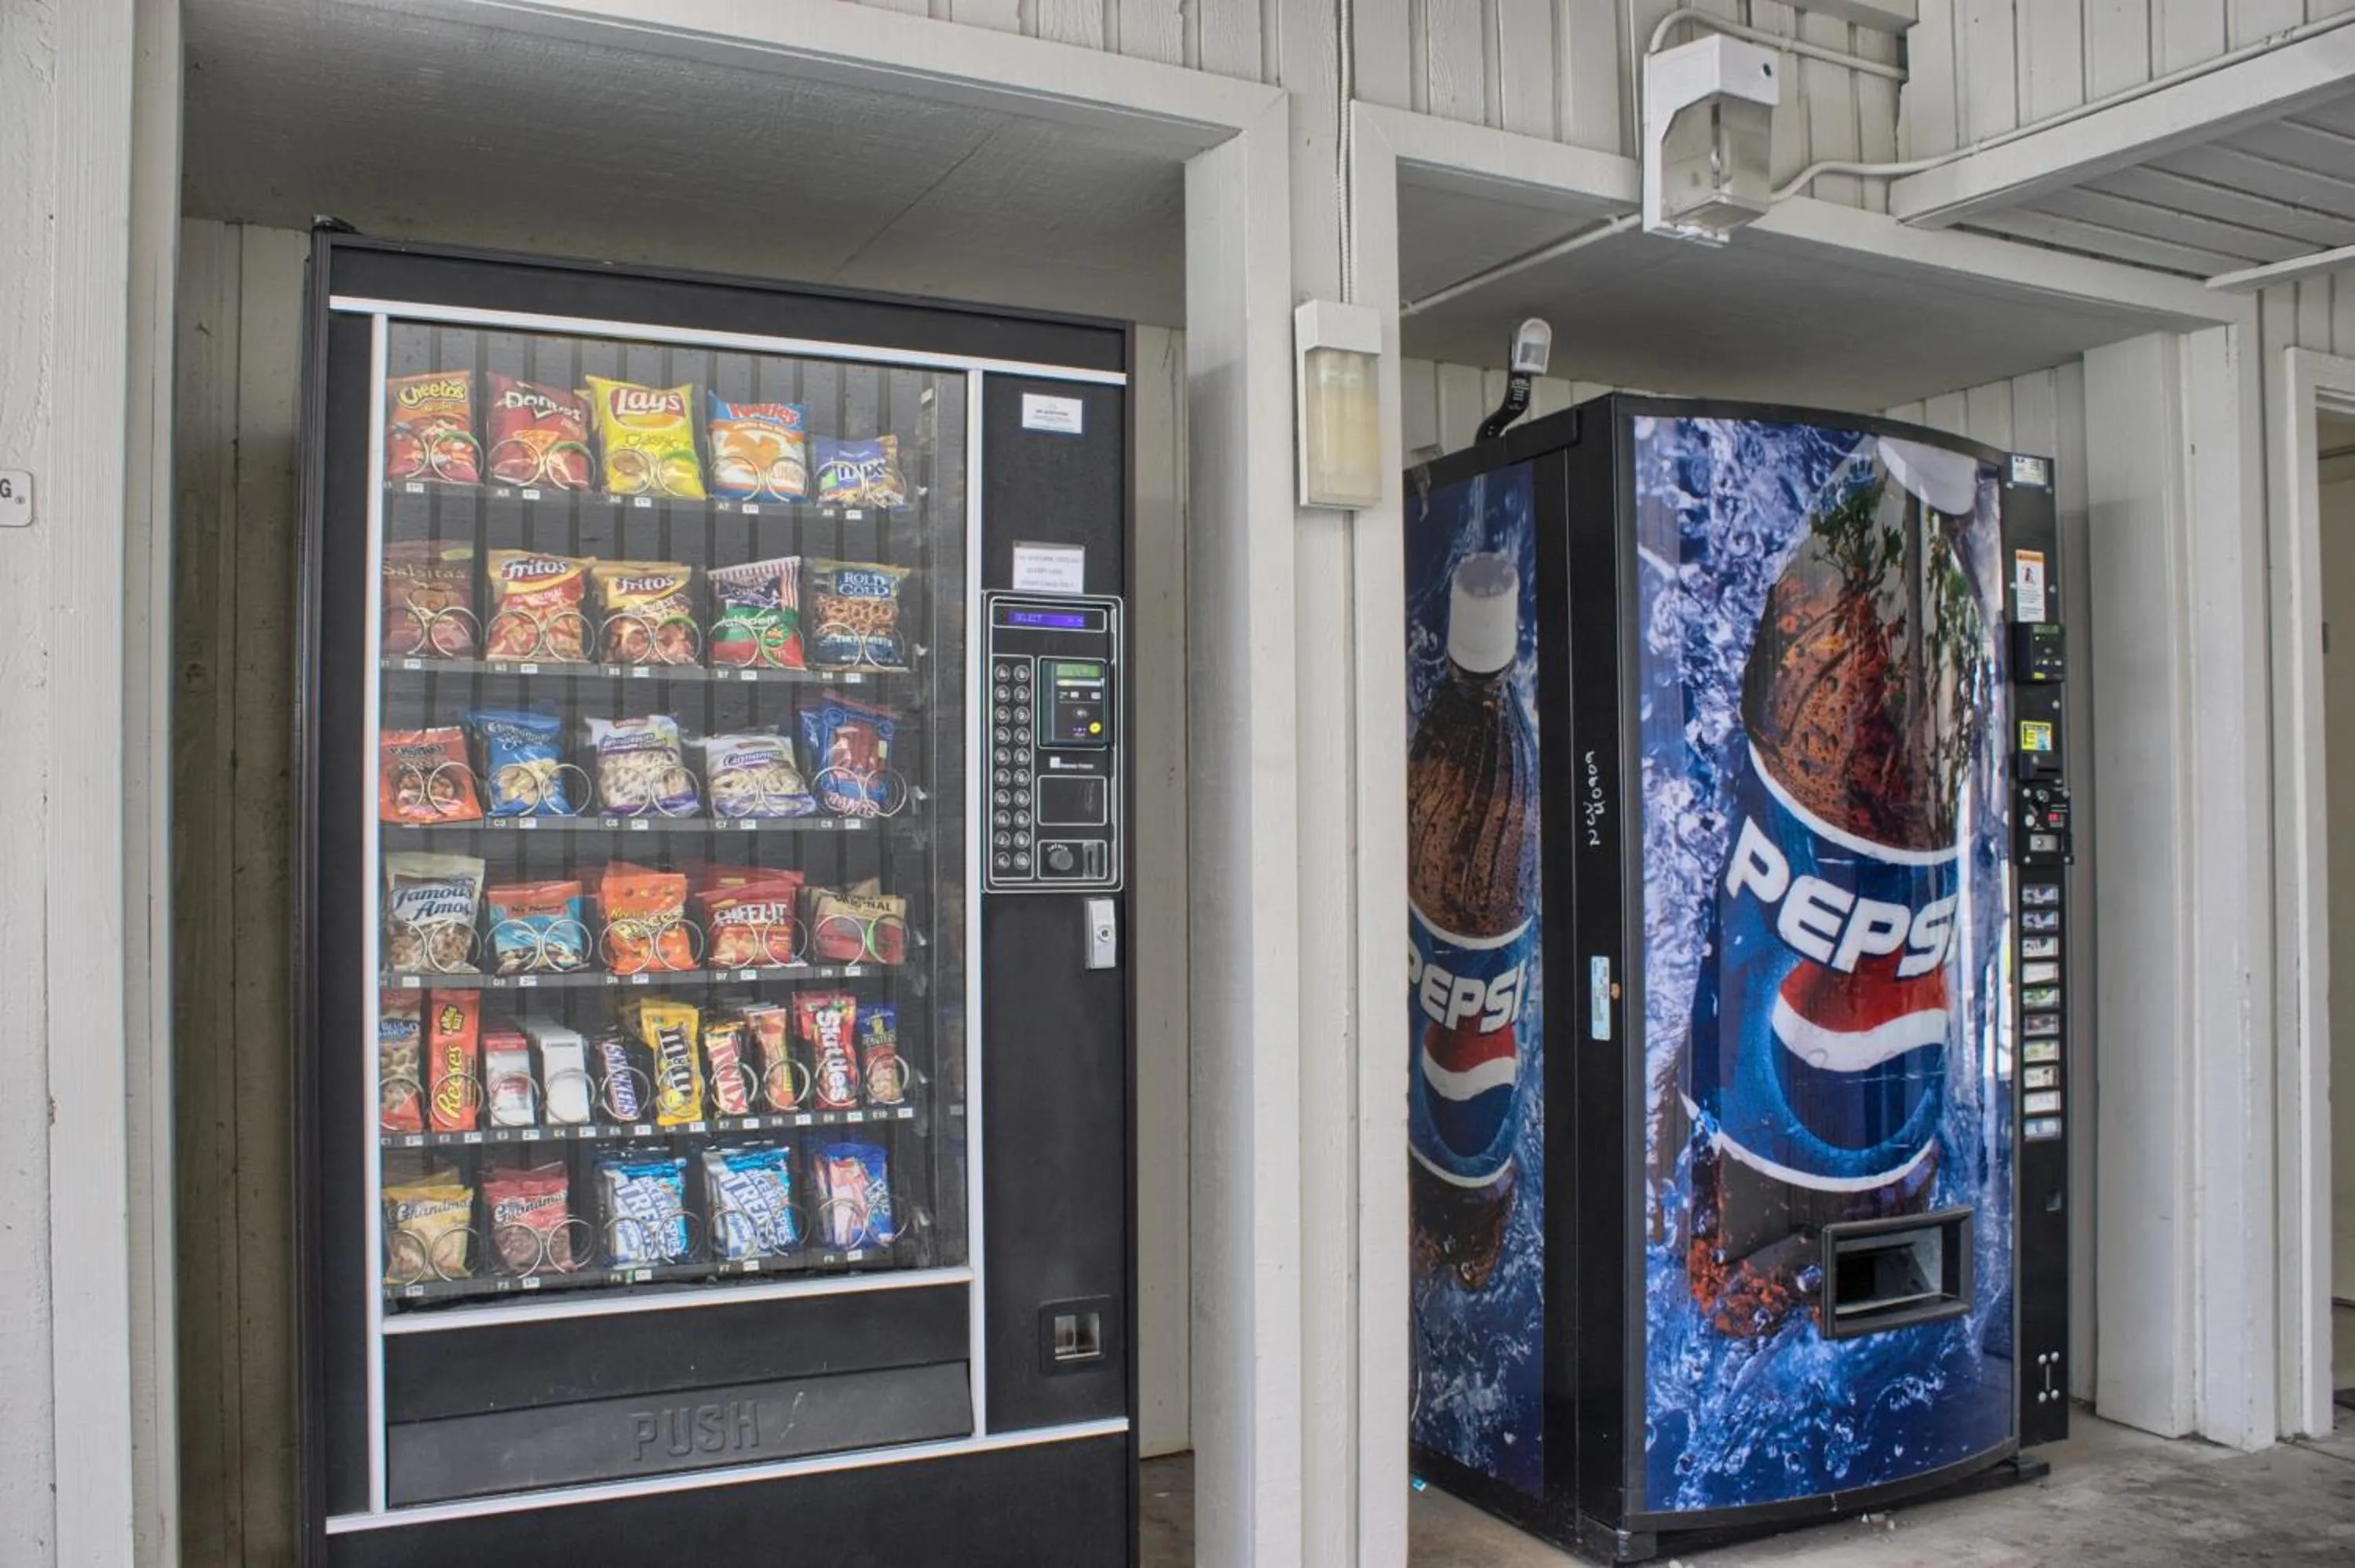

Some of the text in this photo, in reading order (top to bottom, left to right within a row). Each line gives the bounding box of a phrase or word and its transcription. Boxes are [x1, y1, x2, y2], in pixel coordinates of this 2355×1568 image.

[399, 381, 466, 405] Cheetos
[838, 583, 889, 596] GOLD
[844, 571, 885, 585] ROLD
[1726, 816, 1959, 978] PEPSI
[1409, 938, 1525, 1034] PEPSI
[436, 1044, 462, 1118] Reese's
[631, 1398, 760, 1461] PUSH
